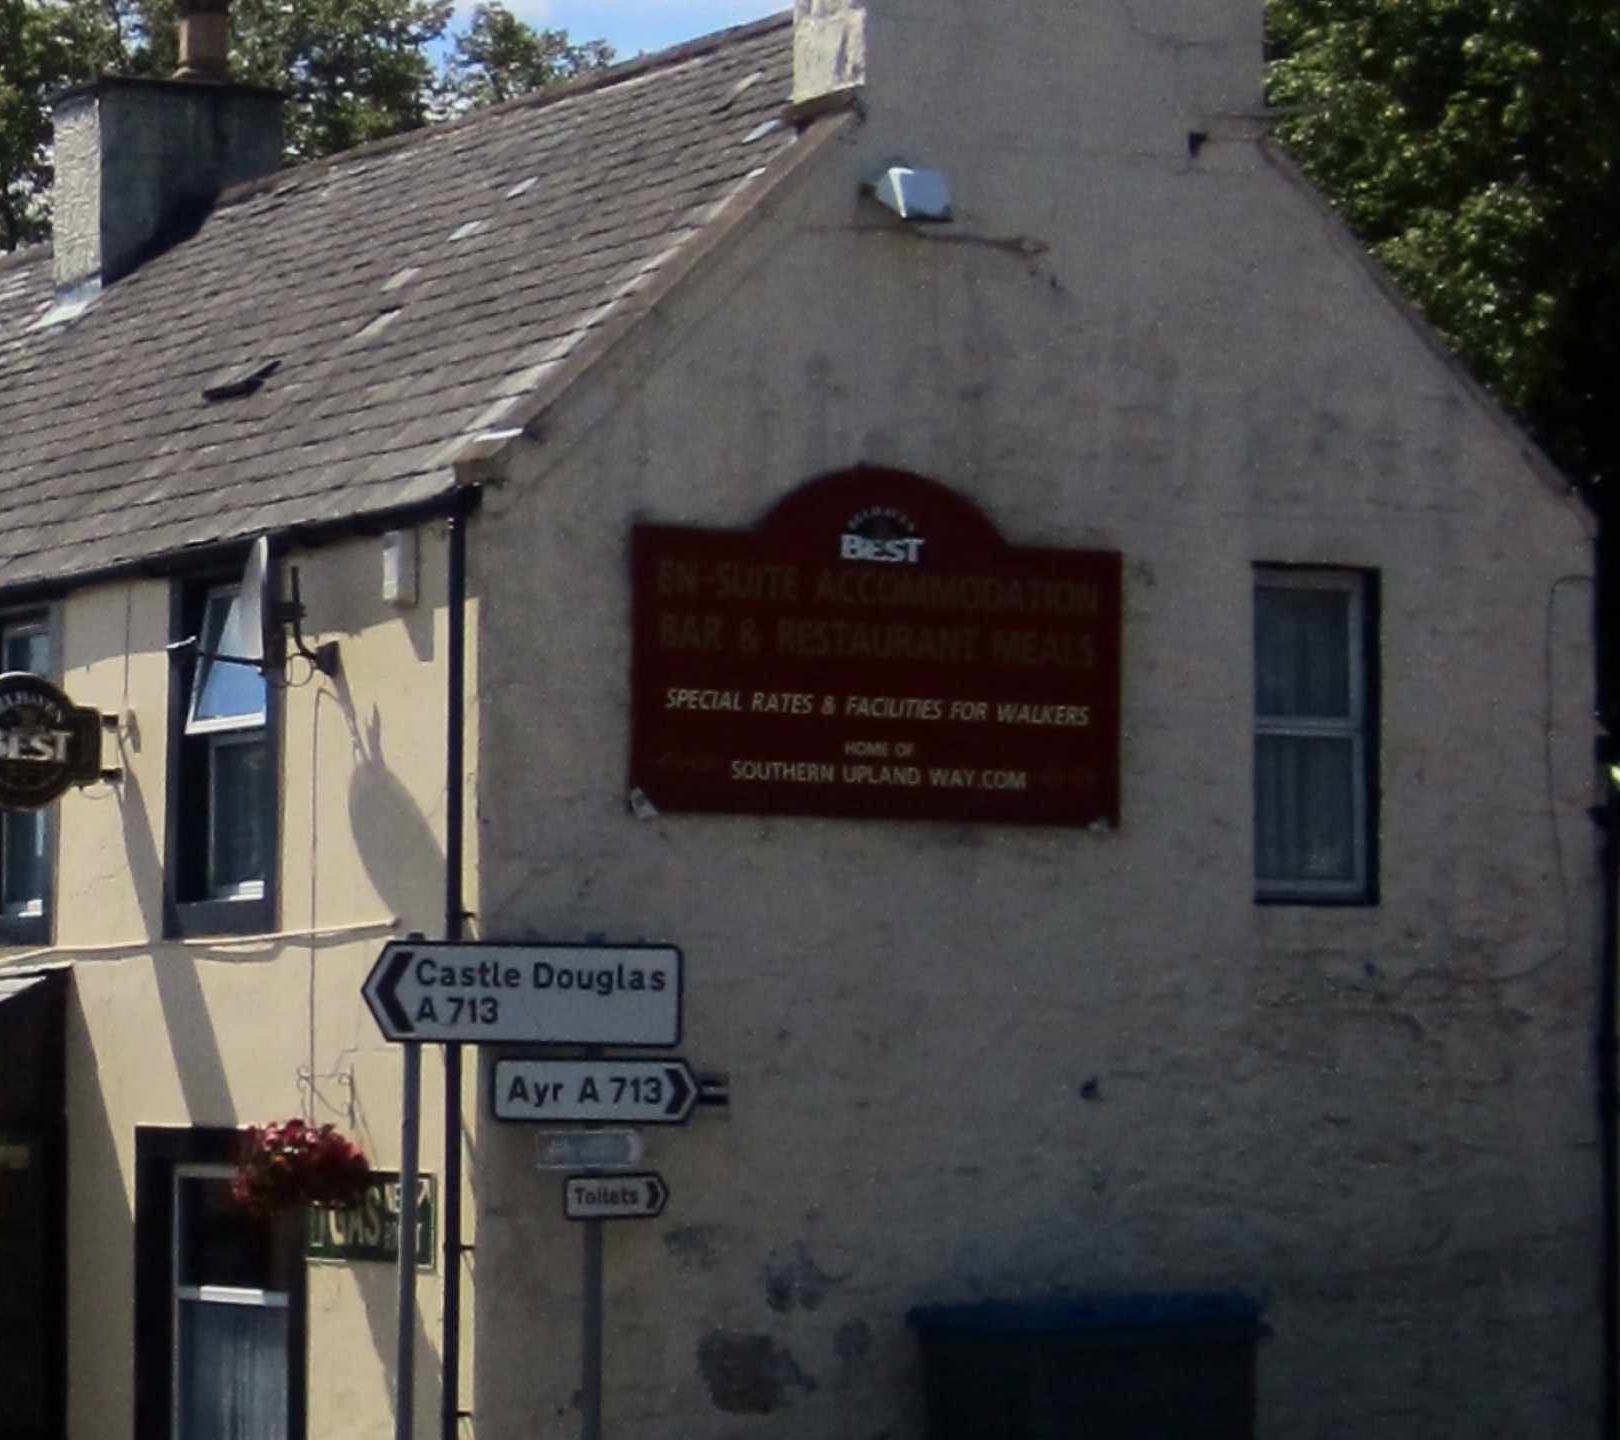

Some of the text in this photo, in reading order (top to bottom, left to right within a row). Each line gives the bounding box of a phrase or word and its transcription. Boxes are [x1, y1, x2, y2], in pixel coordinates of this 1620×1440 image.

[840, 533, 925, 563] BEST
[658, 560, 1099, 614] EN-SUITE ACCOMMODATION
[660, 614, 1095, 667] BAR & RESTAURANT MEALS
[665, 688, 1090, 726] SPECIAL RATES & FACILITIES FOR WALKERS
[844, 741, 915, 758] HOME OF
[731, 760, 1027, 791] SOUTHERN UPLAND WAY.COM
[415, 959, 666, 995] Castle Douglas
[508, 1076, 564, 1107] Ayr
[574, 1187, 639, 1205] Toilets
